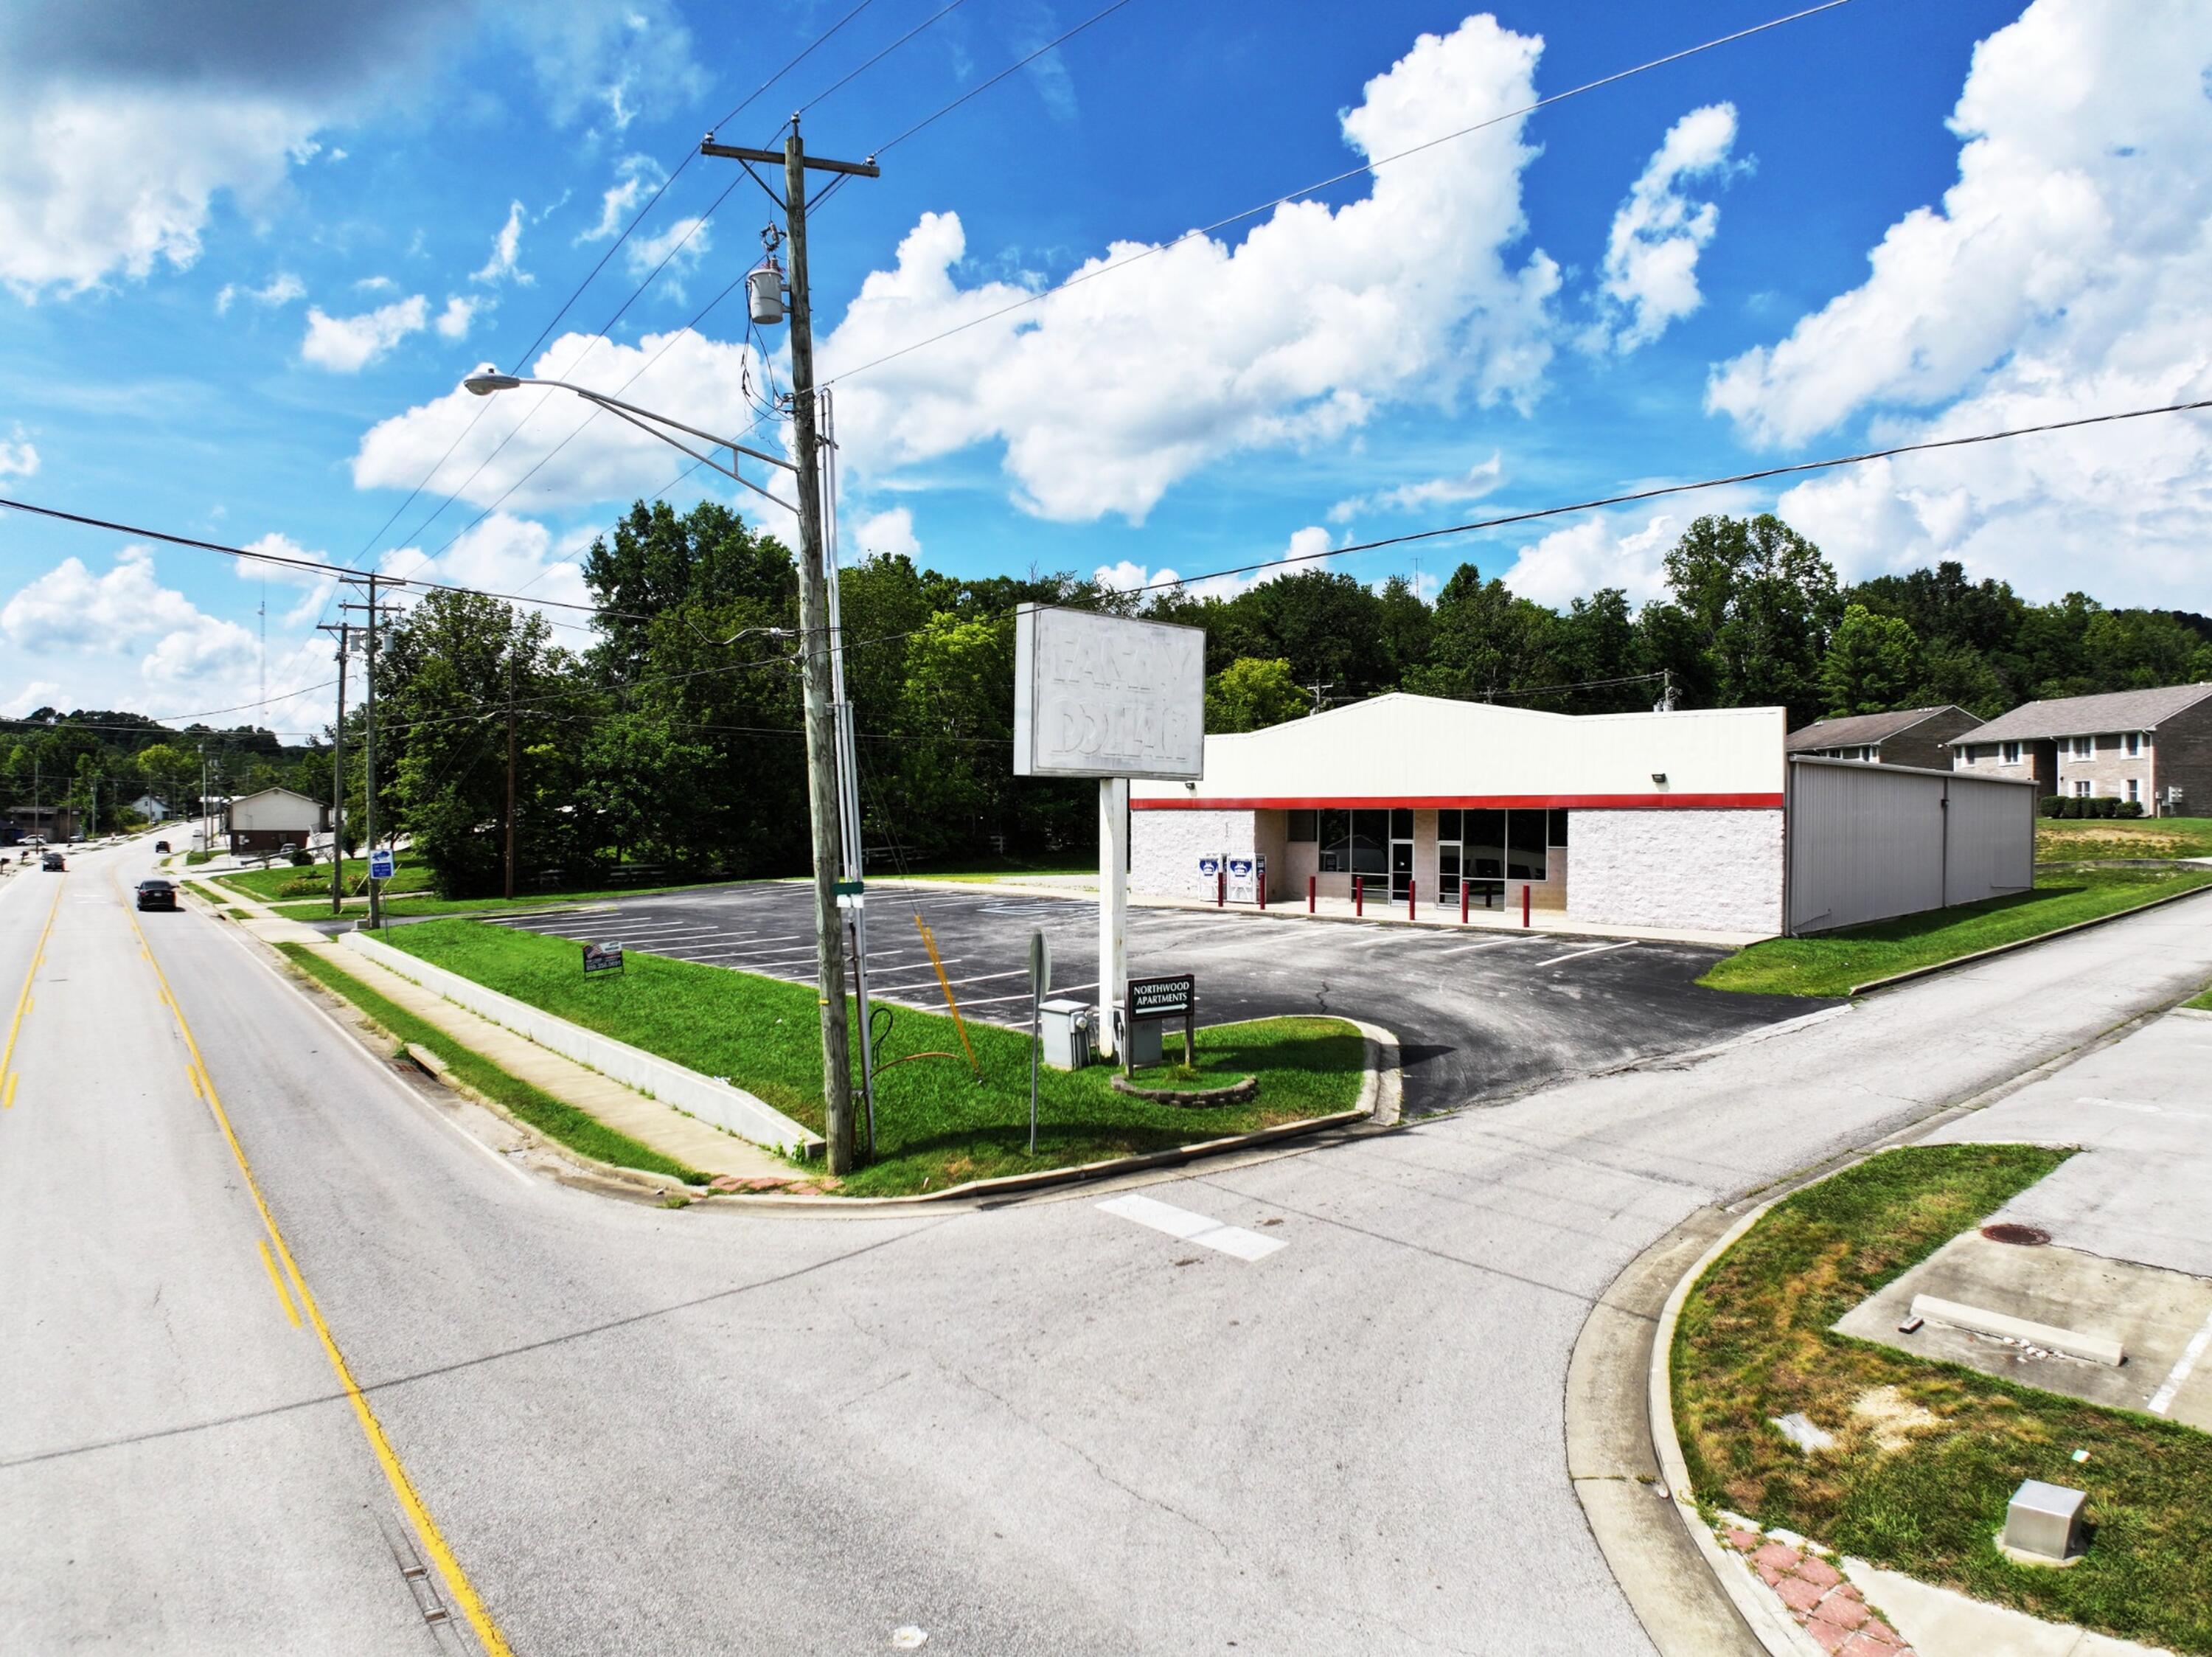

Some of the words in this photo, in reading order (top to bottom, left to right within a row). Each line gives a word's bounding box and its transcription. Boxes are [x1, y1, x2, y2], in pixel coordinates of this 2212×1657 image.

[1051, 634, 1191, 691] FAMY
[1133, 982, 1189, 995] NORTHWOOD
[1136, 993, 1187, 1005] APARTMENTS
